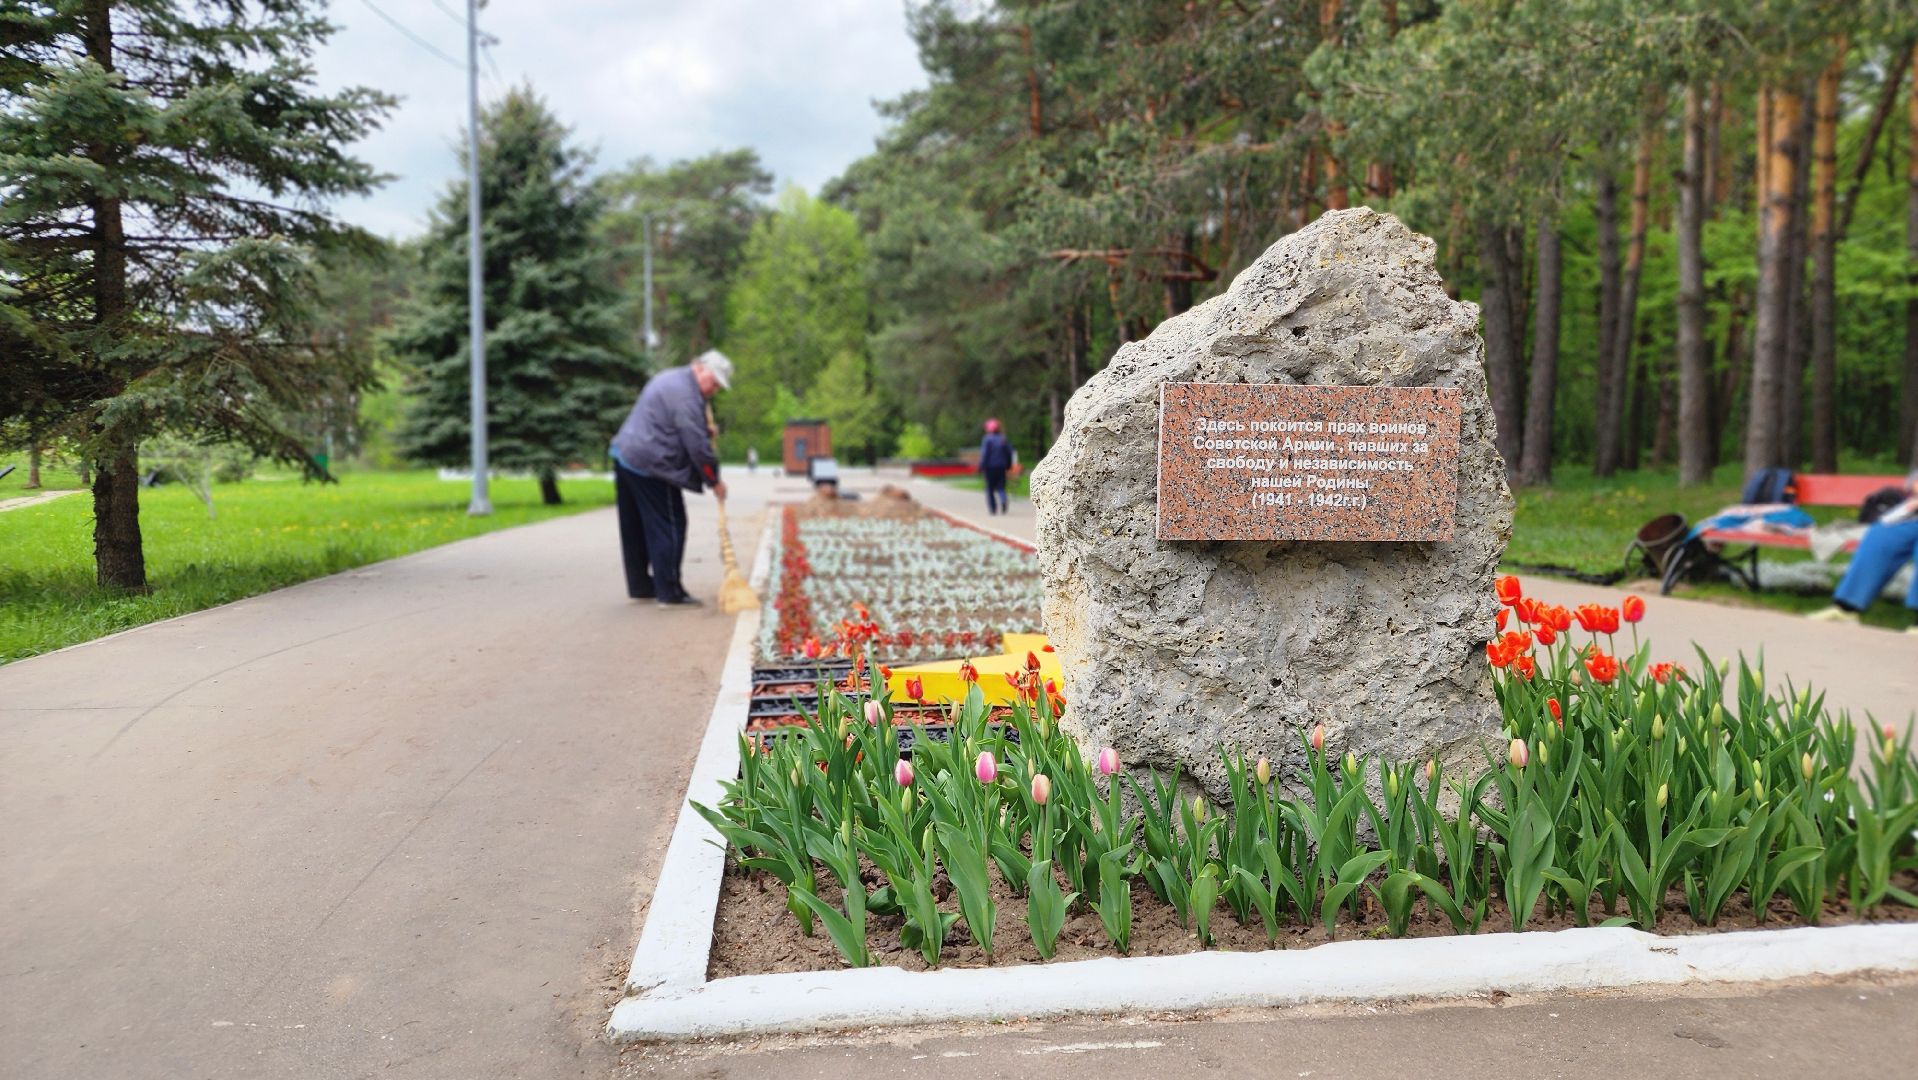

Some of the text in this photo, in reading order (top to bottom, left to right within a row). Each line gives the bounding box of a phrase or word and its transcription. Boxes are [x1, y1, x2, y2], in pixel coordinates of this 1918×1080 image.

[1197, 417, 1427, 435] Здесь покоится прах воинов
[1193, 436, 1278, 450] Советской
[1282, 436, 1335, 453] Армии
[1348, 441, 1408, 452] павших
[1412, 442, 1429, 453] за
[1207, 455, 1414, 472] свободу и независимость
[1251, 474, 1369, 490] нашей Родины
[1252, 492, 1292, 509] (1941
